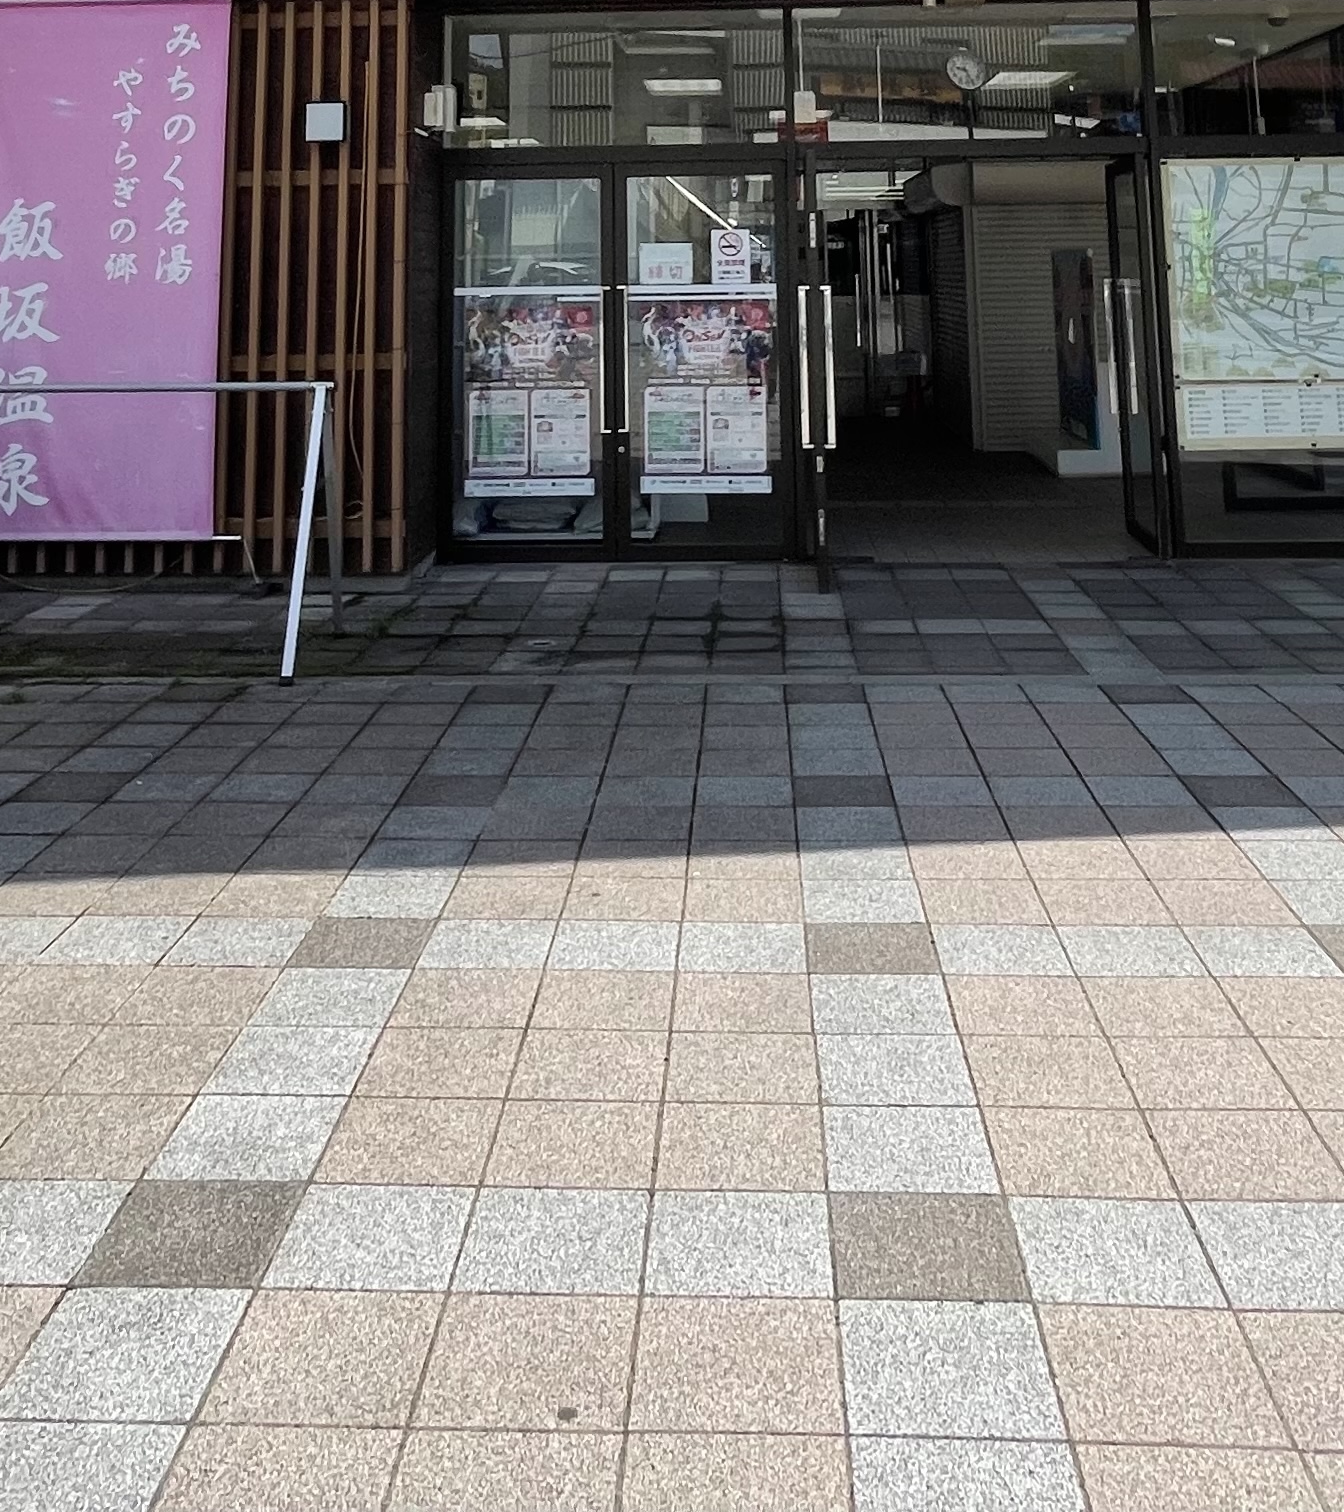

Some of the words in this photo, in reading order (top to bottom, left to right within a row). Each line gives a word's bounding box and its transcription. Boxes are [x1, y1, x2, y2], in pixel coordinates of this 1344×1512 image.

[103, 67, 144, 284] やすらぎの郷
[153, 22, 202, 286] みちのく名湯
